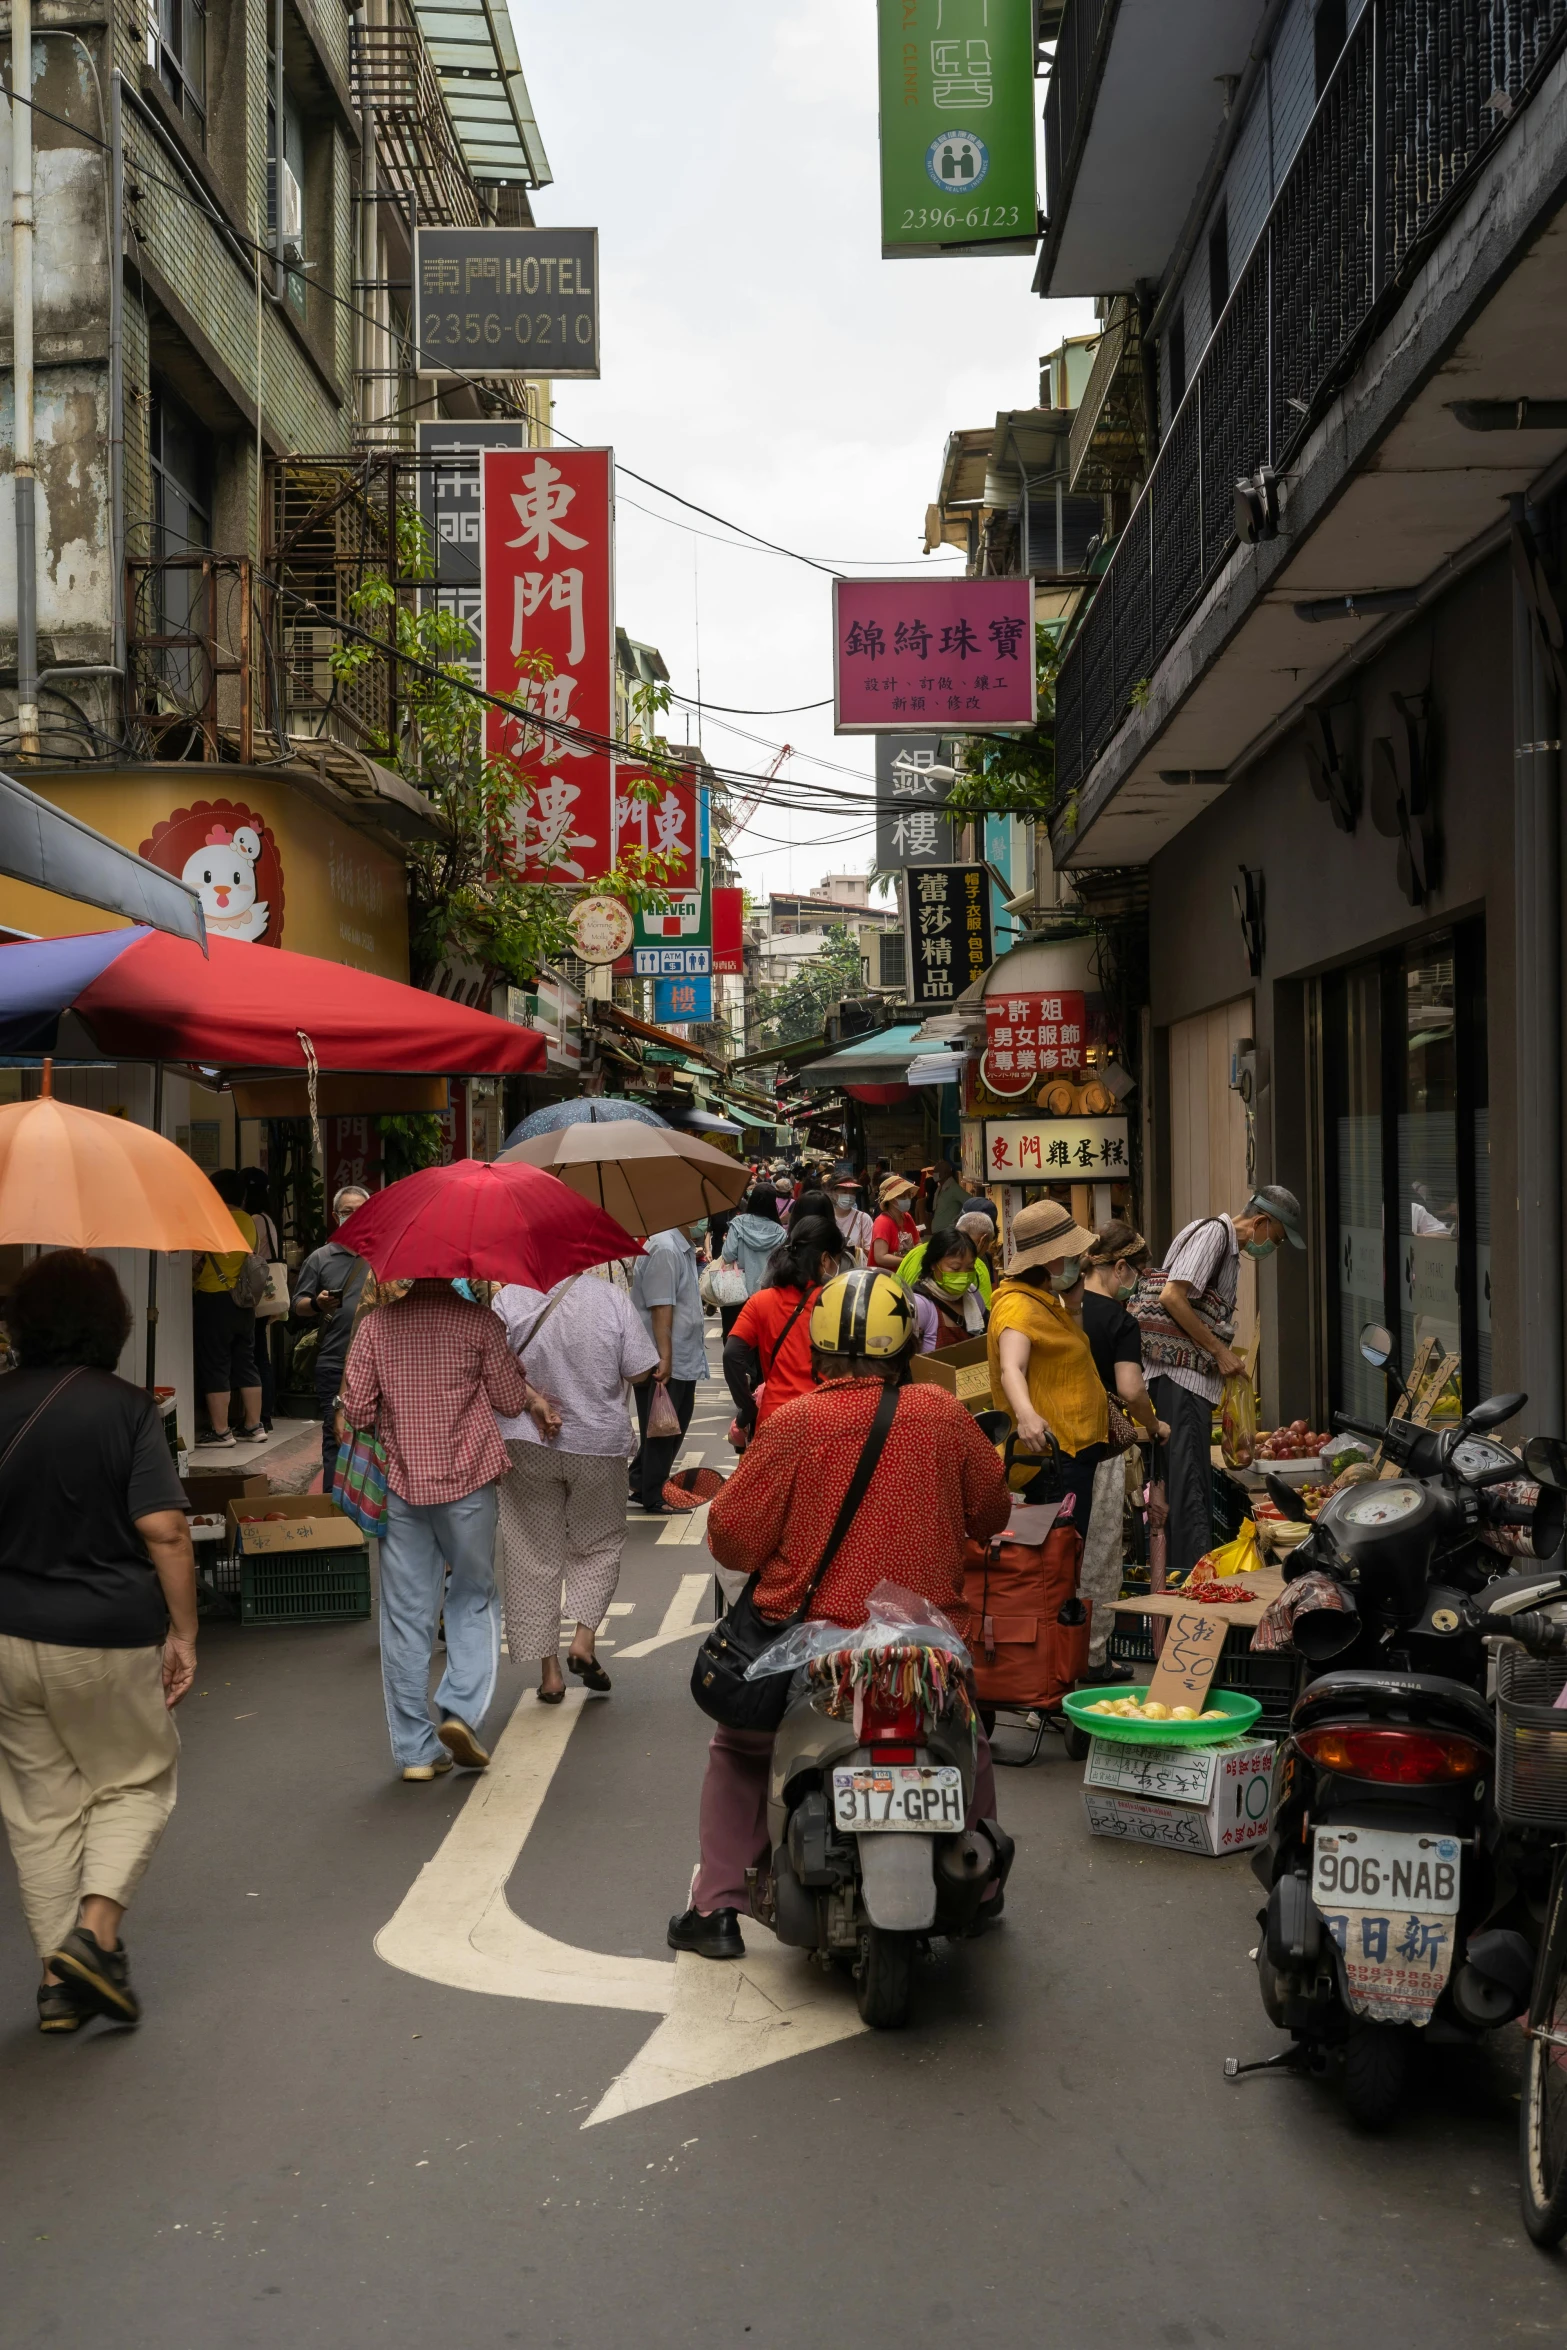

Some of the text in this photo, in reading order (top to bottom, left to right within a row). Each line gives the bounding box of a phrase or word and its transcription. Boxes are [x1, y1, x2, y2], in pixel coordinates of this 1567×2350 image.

[903, 43, 919, 107] CLINIC
[901, 207, 1019, 229] 2396-6123
[506, 257, 592, 295] HOTEL
[424, 313, 593, 344] 2356-0210
[844, 616, 1027, 662] 錦綺珠寶
[501, 457, 596, 879] 東門銀樓
[917, 873, 954, 997] 蕾莎精品
[994, 1024, 1080, 1048] 男女服飾
[994, 1048, 1081, 1071] 專業修改
[991, 1135, 1128, 1171] 東門雞蛋糕
[1162, 1641, 1214, 1676] 50
[1377, 1680, 1422, 1690] YAMAHA
[1347, 1964, 1443, 1981] 89838853
